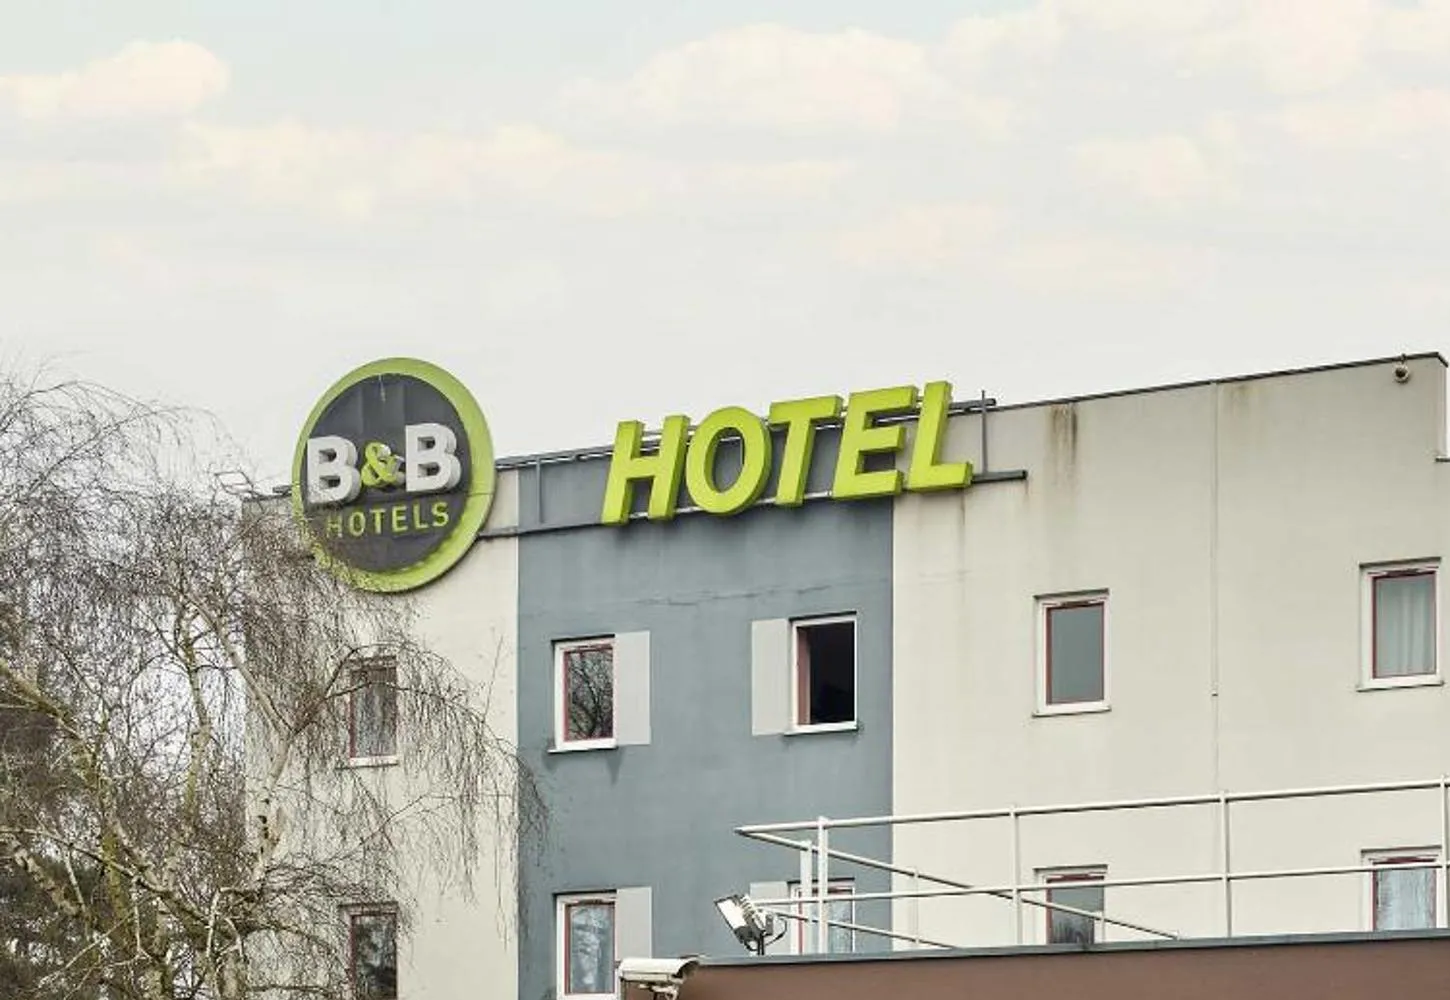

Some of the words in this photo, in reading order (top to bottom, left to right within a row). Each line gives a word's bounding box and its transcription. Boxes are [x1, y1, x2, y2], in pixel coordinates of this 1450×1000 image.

[307, 423, 461, 503] B&B
[602, 381, 973, 525] HOTEL
[325, 502, 450, 540] HOTELS
